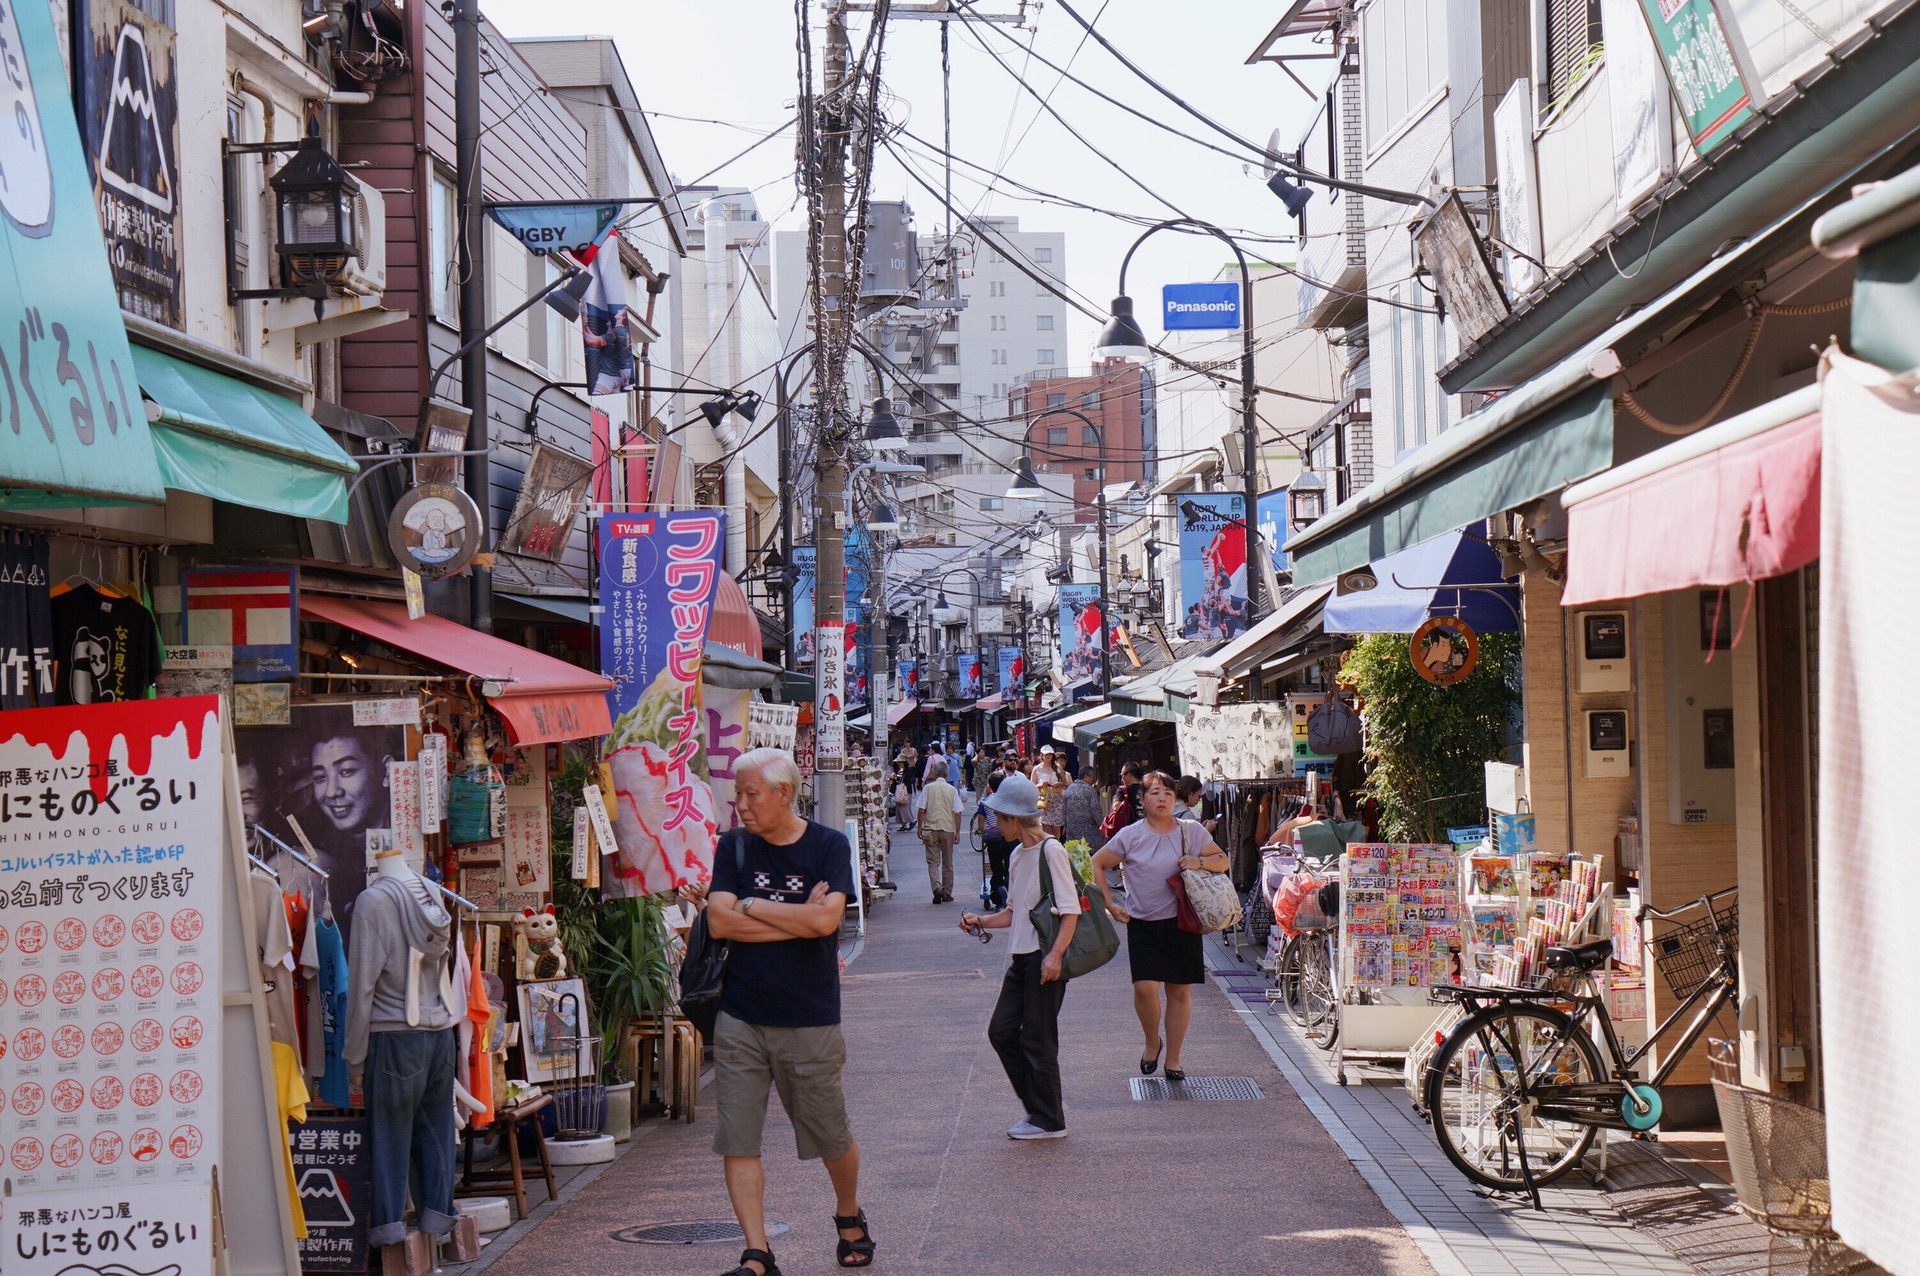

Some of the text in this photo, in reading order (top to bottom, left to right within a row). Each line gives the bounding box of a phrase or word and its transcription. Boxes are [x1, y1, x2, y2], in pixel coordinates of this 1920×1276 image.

[101, 191, 172, 258] 伊藤製作所
[510, 227, 566, 243] UGBY
[891, 258, 906, 270] 100
[1167, 301, 1236, 312] Panasonic
[616, 524, 650, 534] TVで話題
[621, 538, 638, 583] 新食感
[636, 589, 648, 684] ふわふわクリーミー
[113, 625, 130, 702] なに見てん
[256, 664, 292, 672] Postcards
[257, 657, 284, 665] Stamps
[823, 645, 838, 690] かき氷
[1348, 877, 1386, 888] 漢字道
[1355, 891, 1385, 902] 漢字館
[1359, 940, 1390, 951] 漢字メイト
[18, 1202, 132, 1227] 邪悪なハンコ屋
[16, 1220, 197, 1259] しにものぐるい
